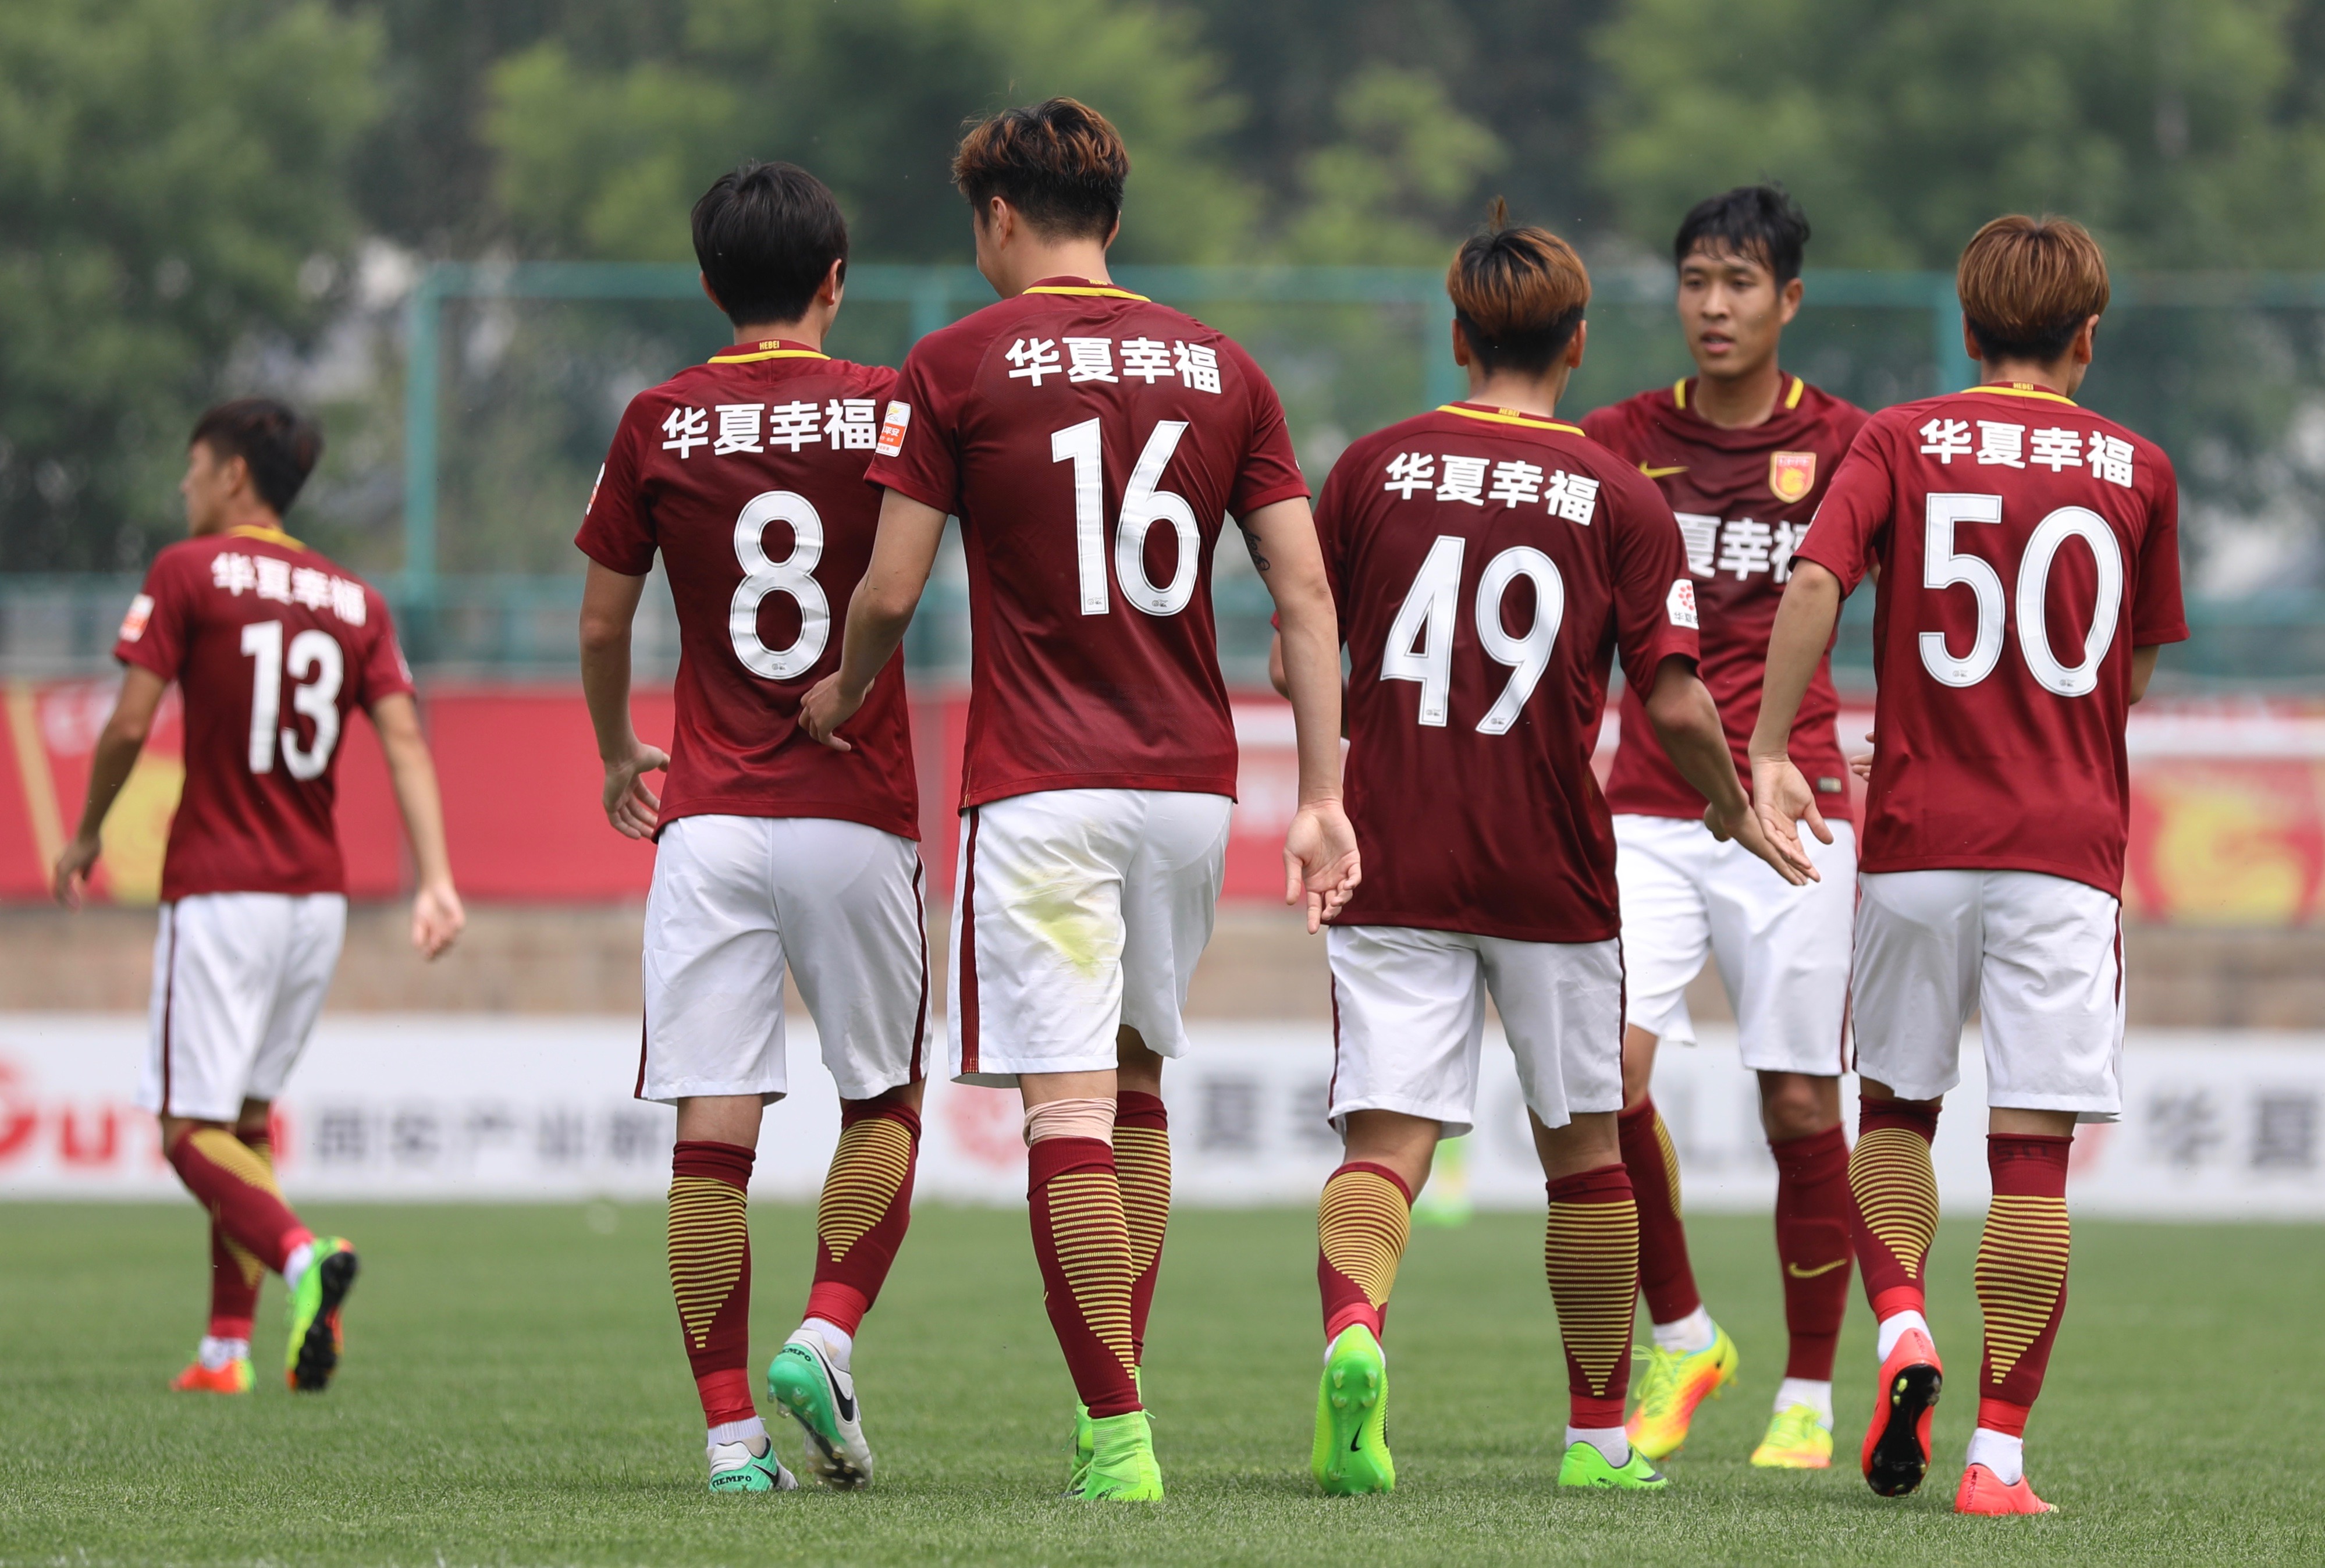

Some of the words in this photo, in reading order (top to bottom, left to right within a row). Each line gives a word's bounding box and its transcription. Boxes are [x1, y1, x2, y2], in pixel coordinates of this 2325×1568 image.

[759, 340, 779, 350] HEBEI
[1005, 337, 1221, 394] 华夏幸福
[2013, 382, 2034, 390] HEBEI
[661, 399, 876, 459] 华夏幸福
[1920, 418, 2134, 488] 华夏幸福
[1051, 417, 1200, 616] 16
[1384, 452, 1599, 526] 华夏幸福
[210, 552, 367, 627] 华夏幸福
[729, 490, 830, 680] 8
[1919, 493, 2123, 697] 50
[1380, 535, 1564, 735] 49
[241, 619, 343, 781] 13
[711, 1475, 752, 1488] TIEMPO
